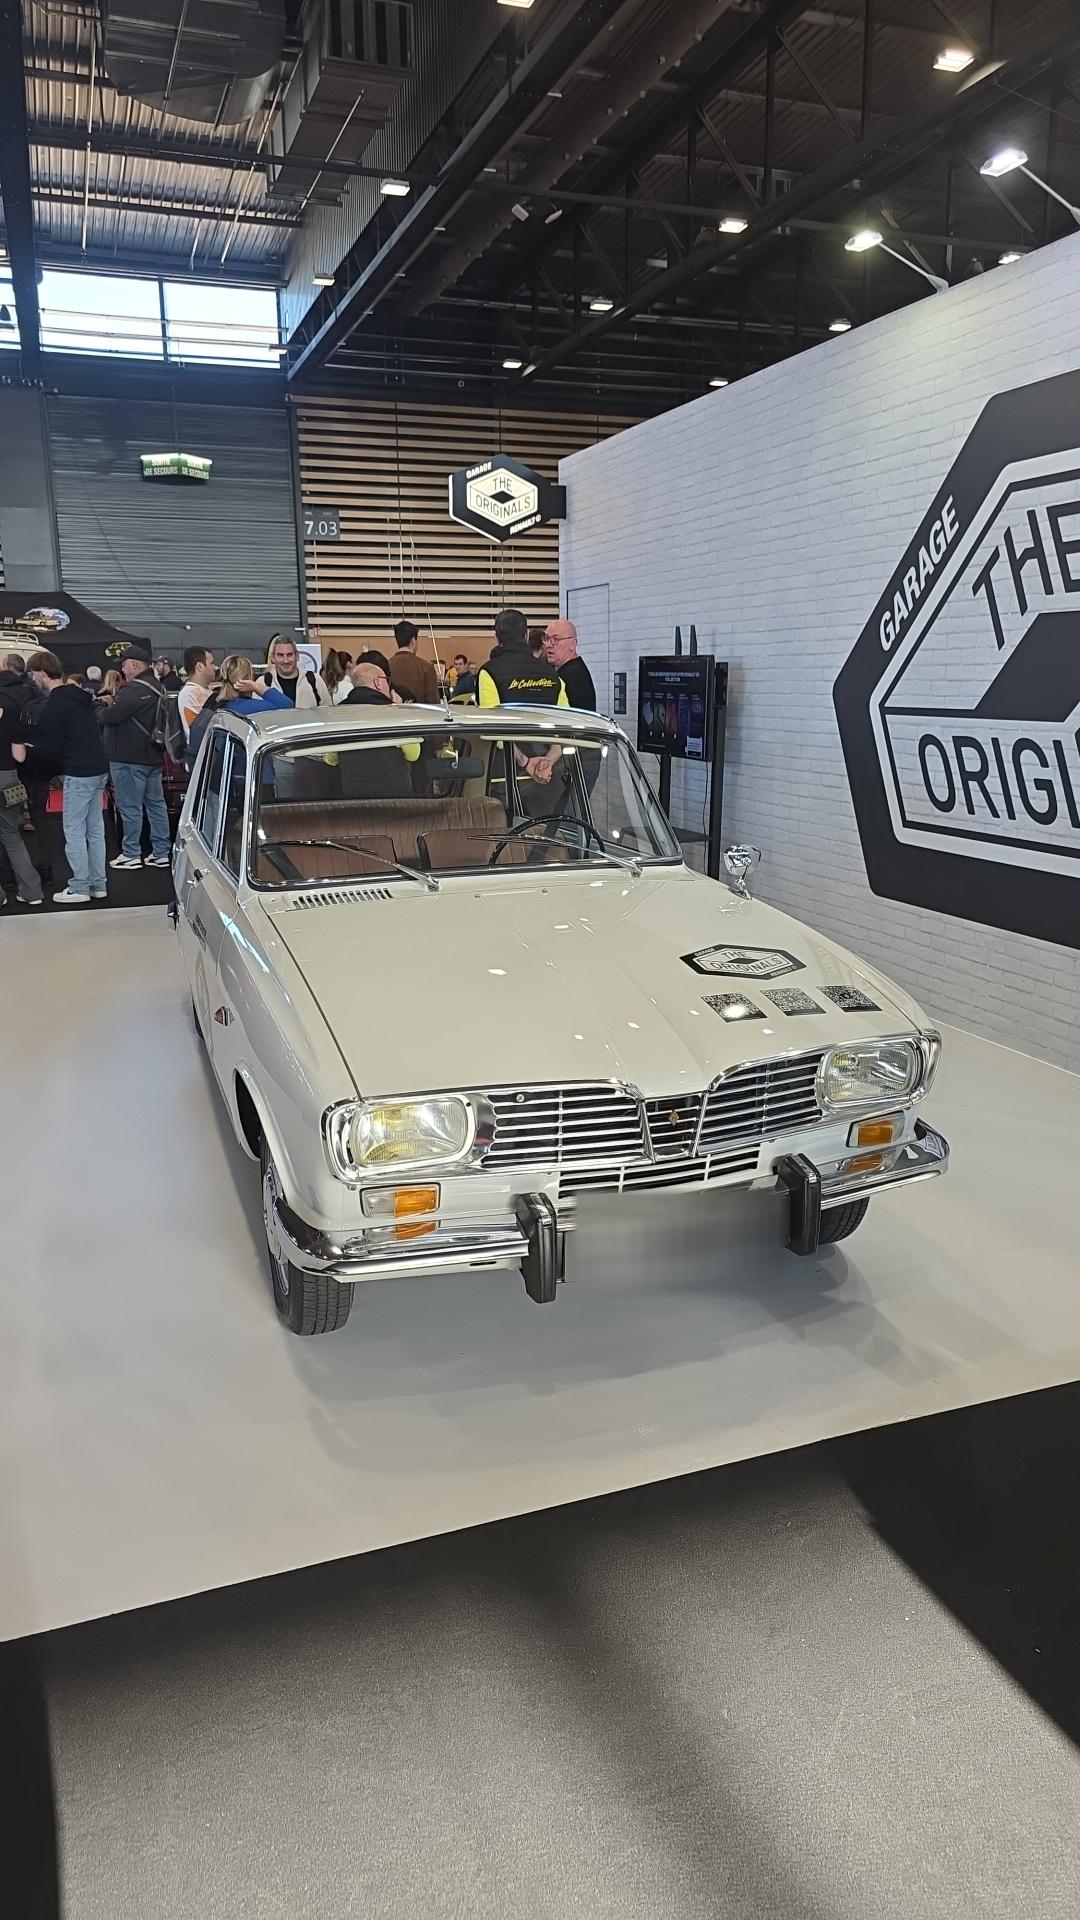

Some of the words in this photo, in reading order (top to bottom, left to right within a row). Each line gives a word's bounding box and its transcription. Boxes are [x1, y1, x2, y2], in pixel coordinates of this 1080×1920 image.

[154, 467, 178, 476] SECOURS
[465, 461, 492, 480] GARAGE
[493, 477, 513, 493] THE
[475, 494, 531, 519] ORIGINALS
[304, 520, 338, 536] 7.03
[879, 494, 961, 652] GARAGE
[971, 500, 1080, 651] THE
[518, 678, 558, 690] Collection
[917, 733, 1080, 830] ORIGI
[720, 950, 748, 960] THE
[710, 957, 783, 973] ORIGINALS
